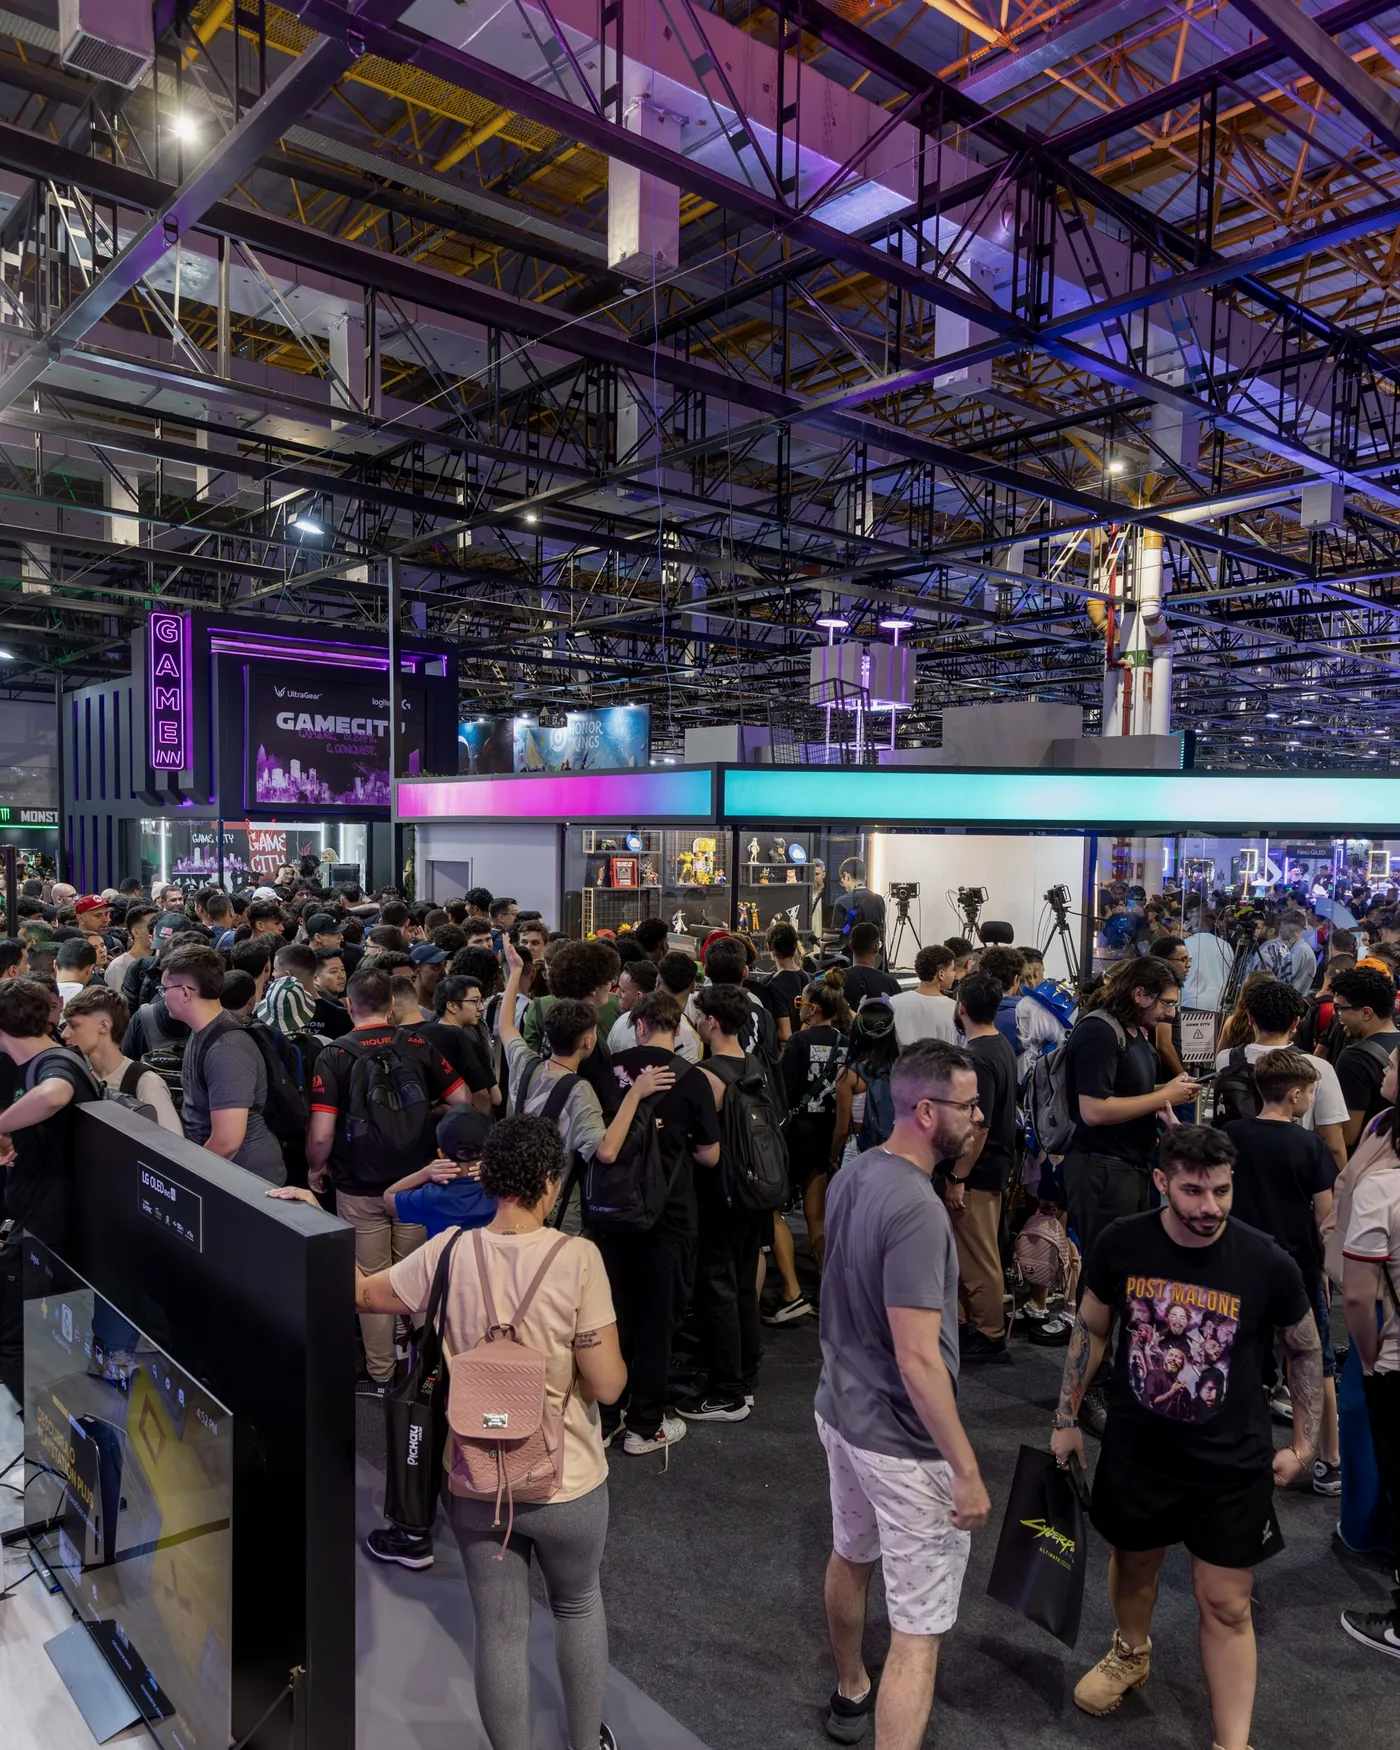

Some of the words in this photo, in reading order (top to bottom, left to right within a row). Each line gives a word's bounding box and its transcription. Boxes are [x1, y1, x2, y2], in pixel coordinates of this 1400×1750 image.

[156, 620, 180, 745] GAME
[287, 690, 320, 700] UltraGear
[276, 712, 406, 737] GAMECIT
[569, 720, 604, 735] HONOR
[156, 750, 181, 764] INN
[248, 832, 287, 852] GAME
[142, 1170, 149, 1185] LG
[150, 1176, 164, 1194] OLED
[1126, 1277, 1167, 1299] POST
[1171, 1282, 1241, 1321] MALONE
[208, 1418, 218, 1436] PM
[77, 1476, 94, 1509] PLUS
